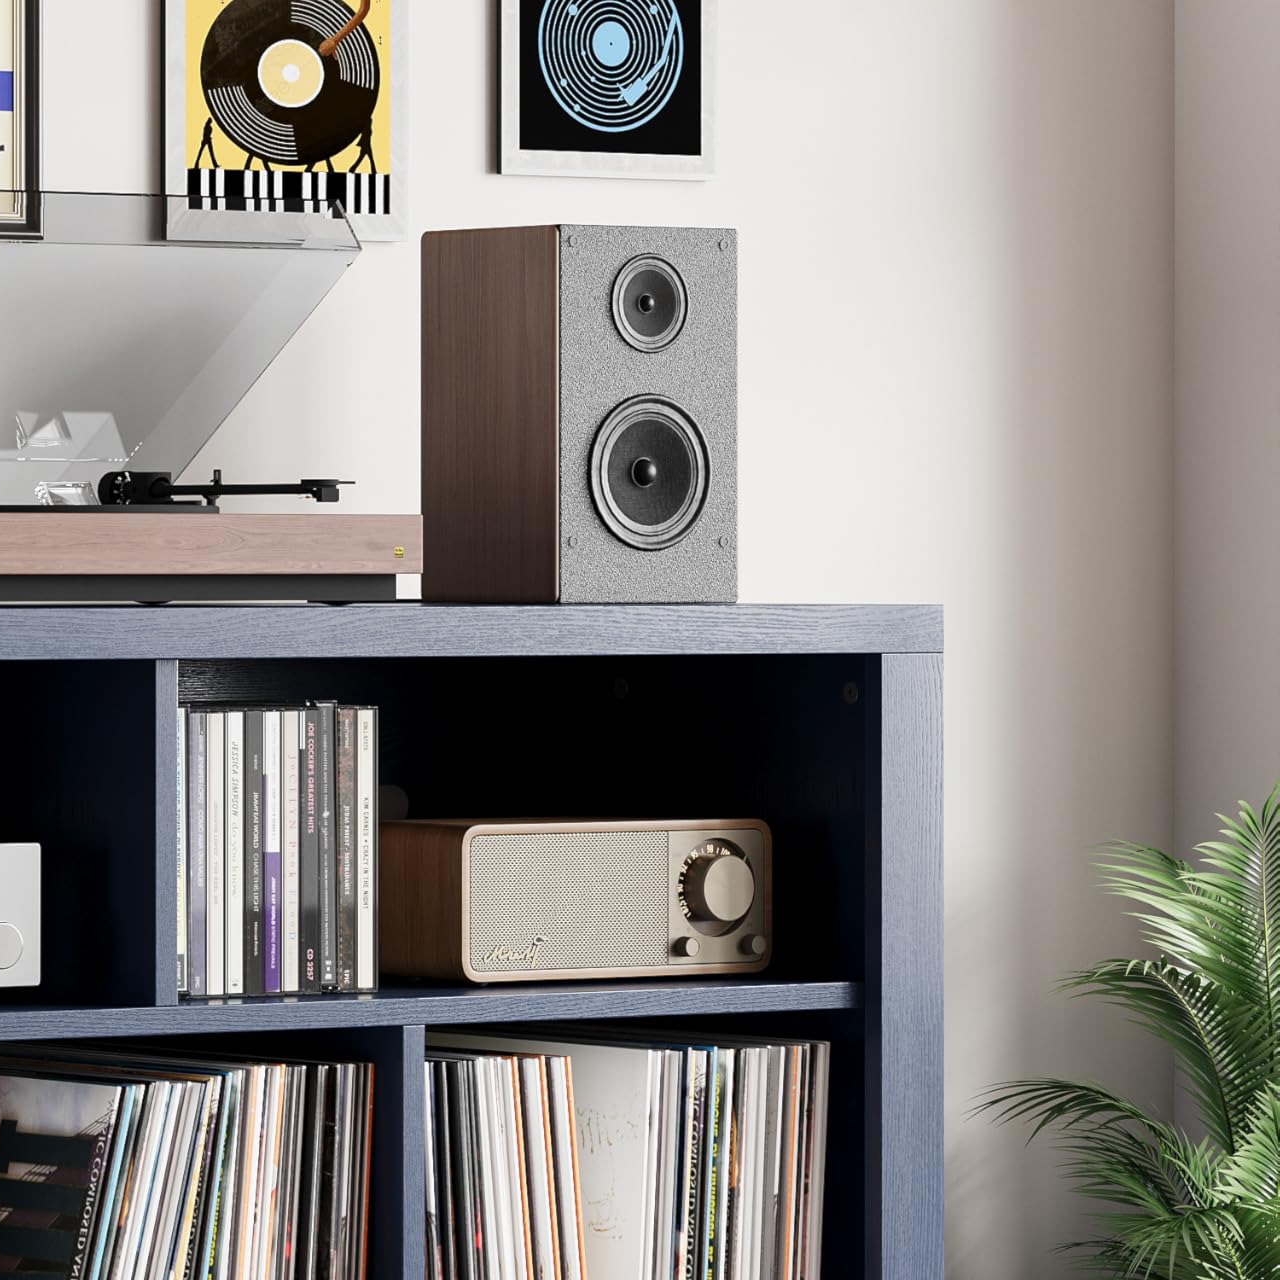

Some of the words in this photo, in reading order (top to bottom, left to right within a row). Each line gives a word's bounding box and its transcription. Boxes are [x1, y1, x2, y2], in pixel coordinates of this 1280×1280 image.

[307, 721, 315, 736] JOE
[231, 741, 239, 774] JESSICA
[307, 738, 315, 775] COCKER'S
[231, 777, 239, 816] SIMPSON
[307, 777, 315, 815] GREATEST
[307, 816, 315, 834] HITS
[306, 948, 314, 959] CD
[306, 961, 314, 980] 3257
